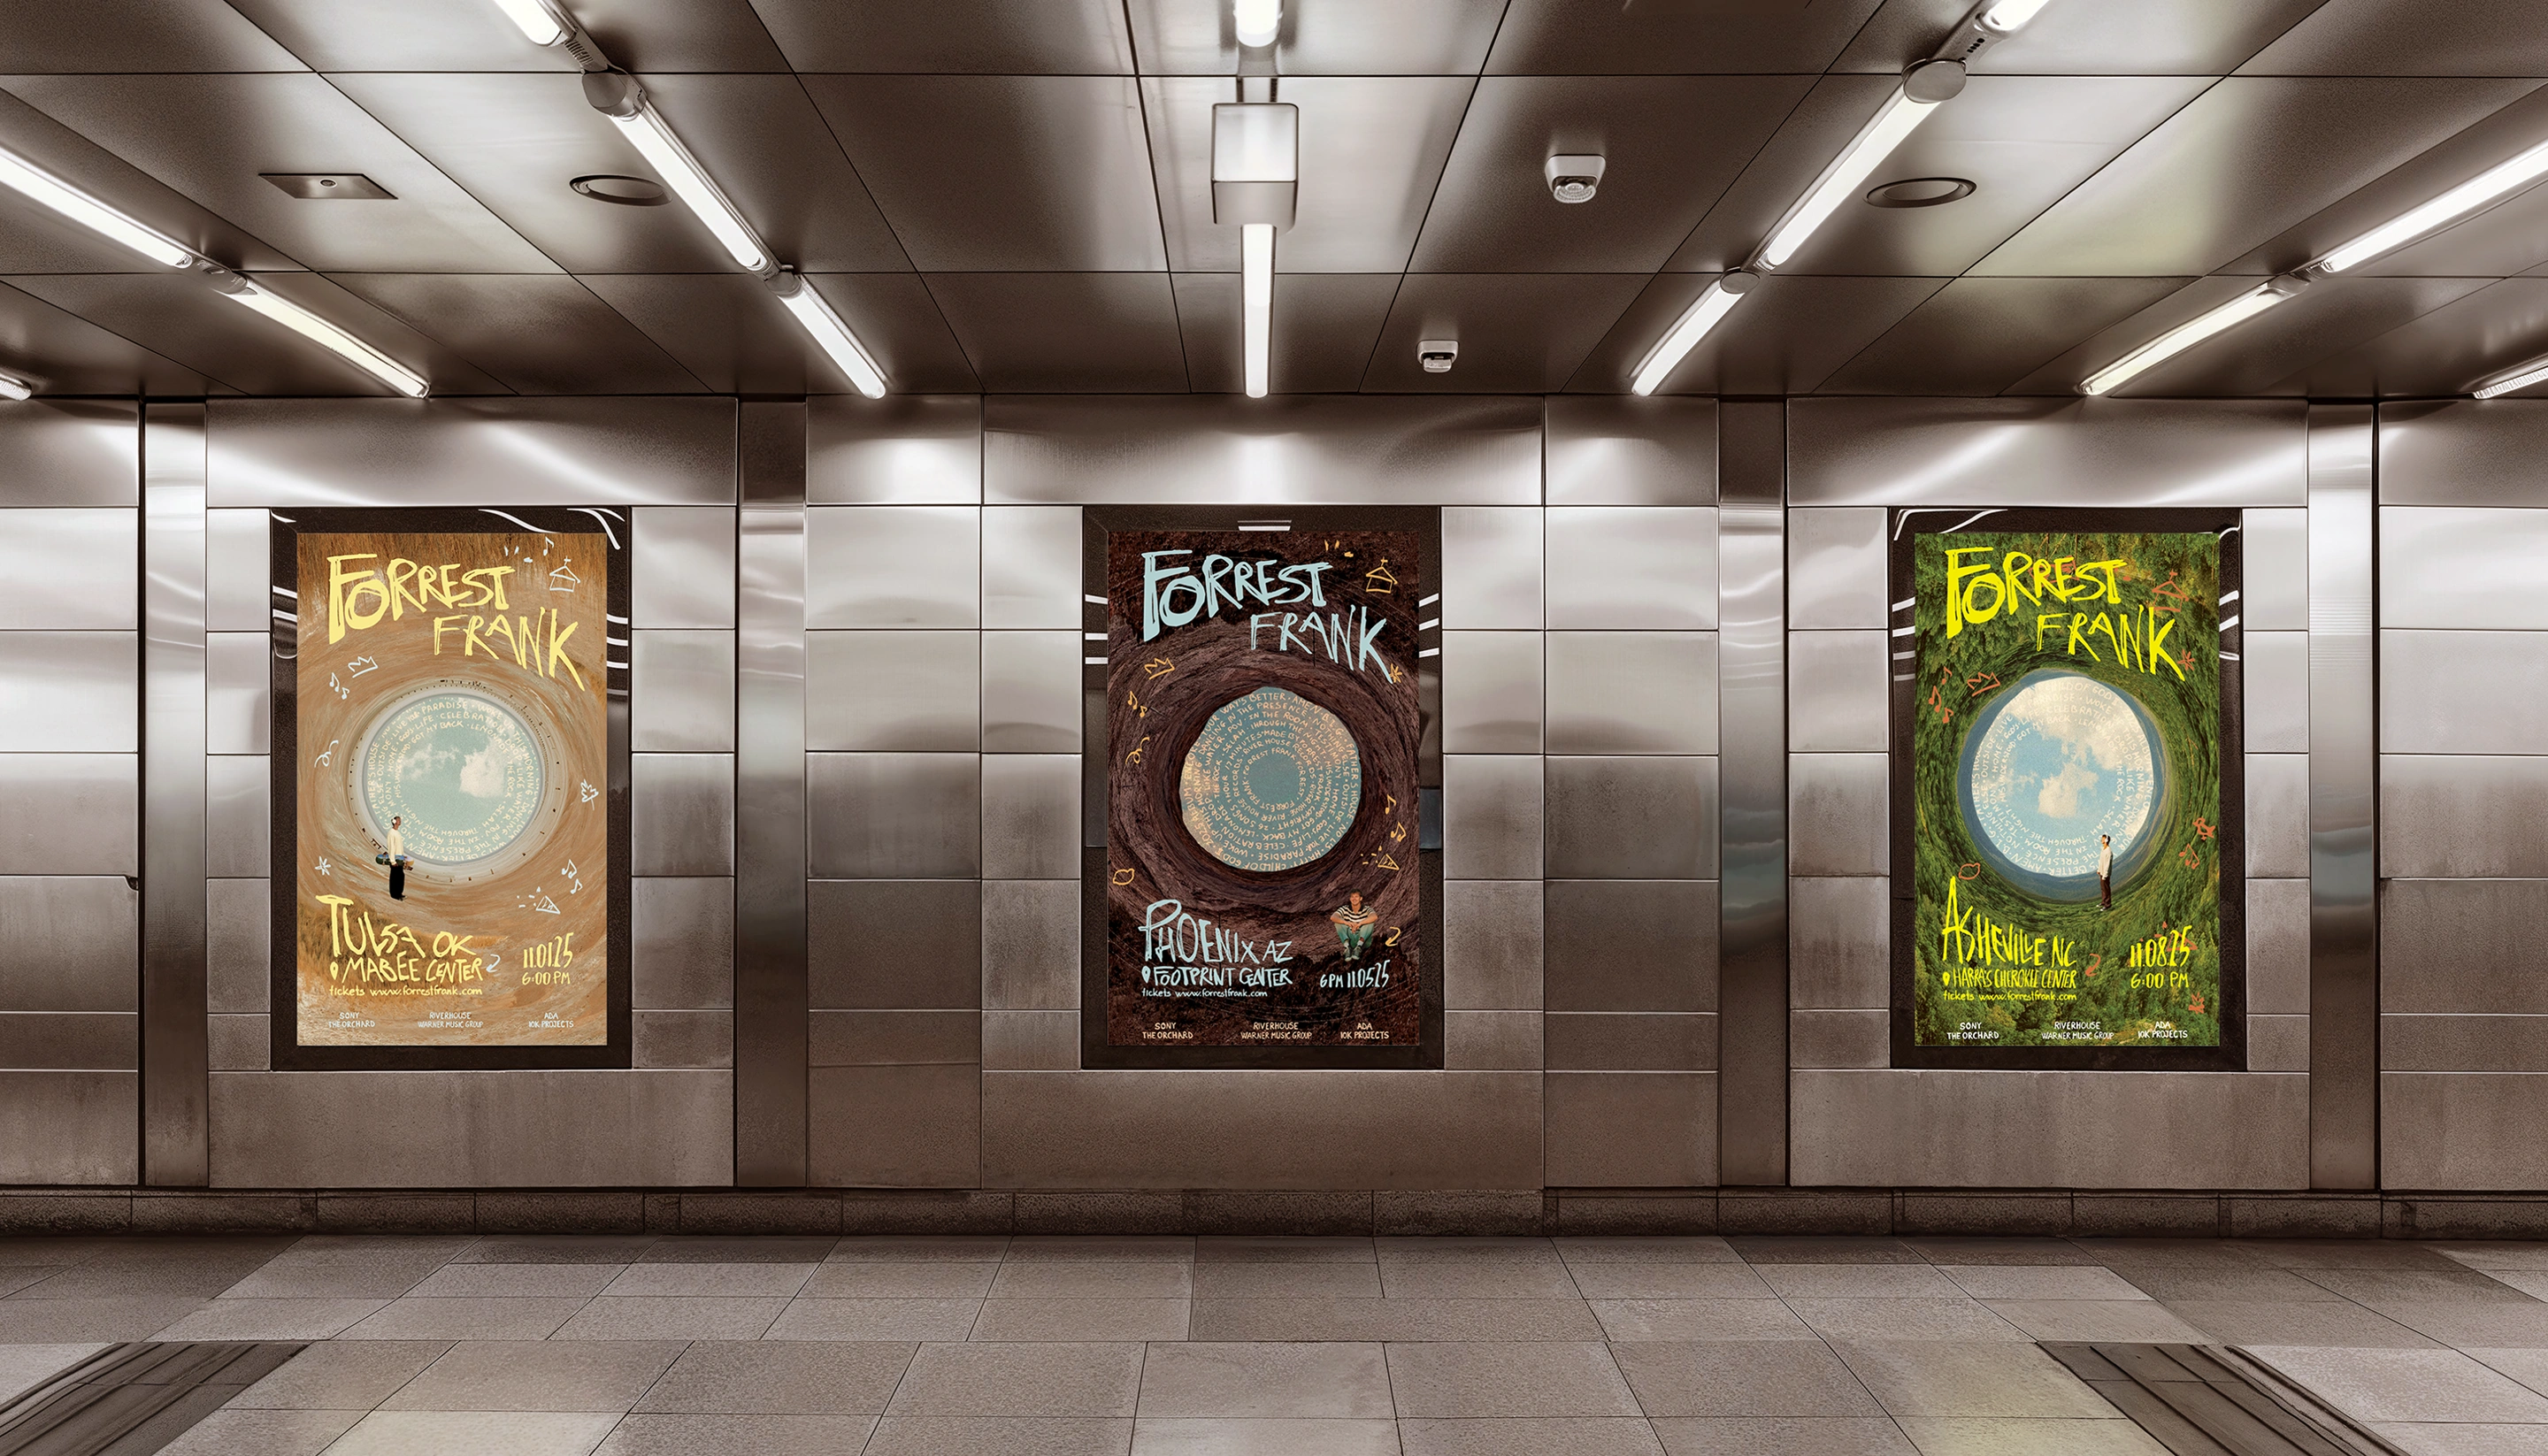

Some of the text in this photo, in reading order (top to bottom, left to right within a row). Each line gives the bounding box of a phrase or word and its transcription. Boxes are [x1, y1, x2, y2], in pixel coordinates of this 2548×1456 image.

[327, 554, 516, 645] FORREST
[1141, 549, 1333, 643] FORREST
[1945, 547, 2128, 640] FORREST
[434, 606, 586, 692] FRANK
[1250, 604, 1393, 684] FRANK
[2037, 604, 2185, 682] FRANK
[421, 701, 468, 715] PARADISE
[1249, 693, 1286, 702] BETTER
[1293, 695, 1322, 714] AMEN
[415, 715, 434, 730] LIFE
[440, 710, 505, 733] CELEBRATION
[1199, 721, 1226, 755] DANCING
[1237, 703, 1255, 716] THE
[1256, 701, 1308, 717] PRESENCE
[1227, 719, 1243, 732] POV
[1283, 711, 1309, 728] ROOM
[1223, 729, 1246, 754] SELAH
[1288, 723, 1304, 733] THE
[1303, 732, 1326, 755] NIGHT
[1312, 717, 1346, 753] NOTHING
[1242, 740, 1264, 755] RIVER
[1265, 738, 1291, 747] HOUSE
[1263, 729, 1286, 738] MADE
[1287, 732, 1300, 744] BY
[1300, 739, 1324, 771] FORREST
[1271, 747, 1296, 761] FRANK
[1230, 804, 1256, 827] SONGS
[1223, 839, 1248, 857] WOKE
[1258, 824, 1334, 862] LIVE PARADISE
[2025, 849, 2079, 865] PRESENCE
[315, 894, 479, 958] TULSA OK
[1138, 899, 1293, 964] PHOENIX AZ
[1941, 876, 2077, 969] ASHEVILLE NC
[341, 950, 483, 984] MABEE CENTER
[521, 970, 571, 985] 6:00 PM
[1153, 966, 1293, 987] FOOTPRINT CENTER
[1994, 968, 2039, 989] CHEROKEE
[2041, 968, 2077, 989] CENTER
[2130, 971, 2190, 989] 6:00 PM
[329, 985, 483, 996] tickets www.forrestfrank.com
[1141, 987, 1268, 998] tickets www.forrestfrank.com
[1943, 990, 2077, 1001] tickets www.forrestfrank.com
[1356, 1022, 1373, 1031] ADA
[1947, 1031, 1999, 1040] THE ORCHARD
[1960, 1022, 1982, 1031] SONY
[2137, 1030, 2188, 1038] 10K PROJECTS
